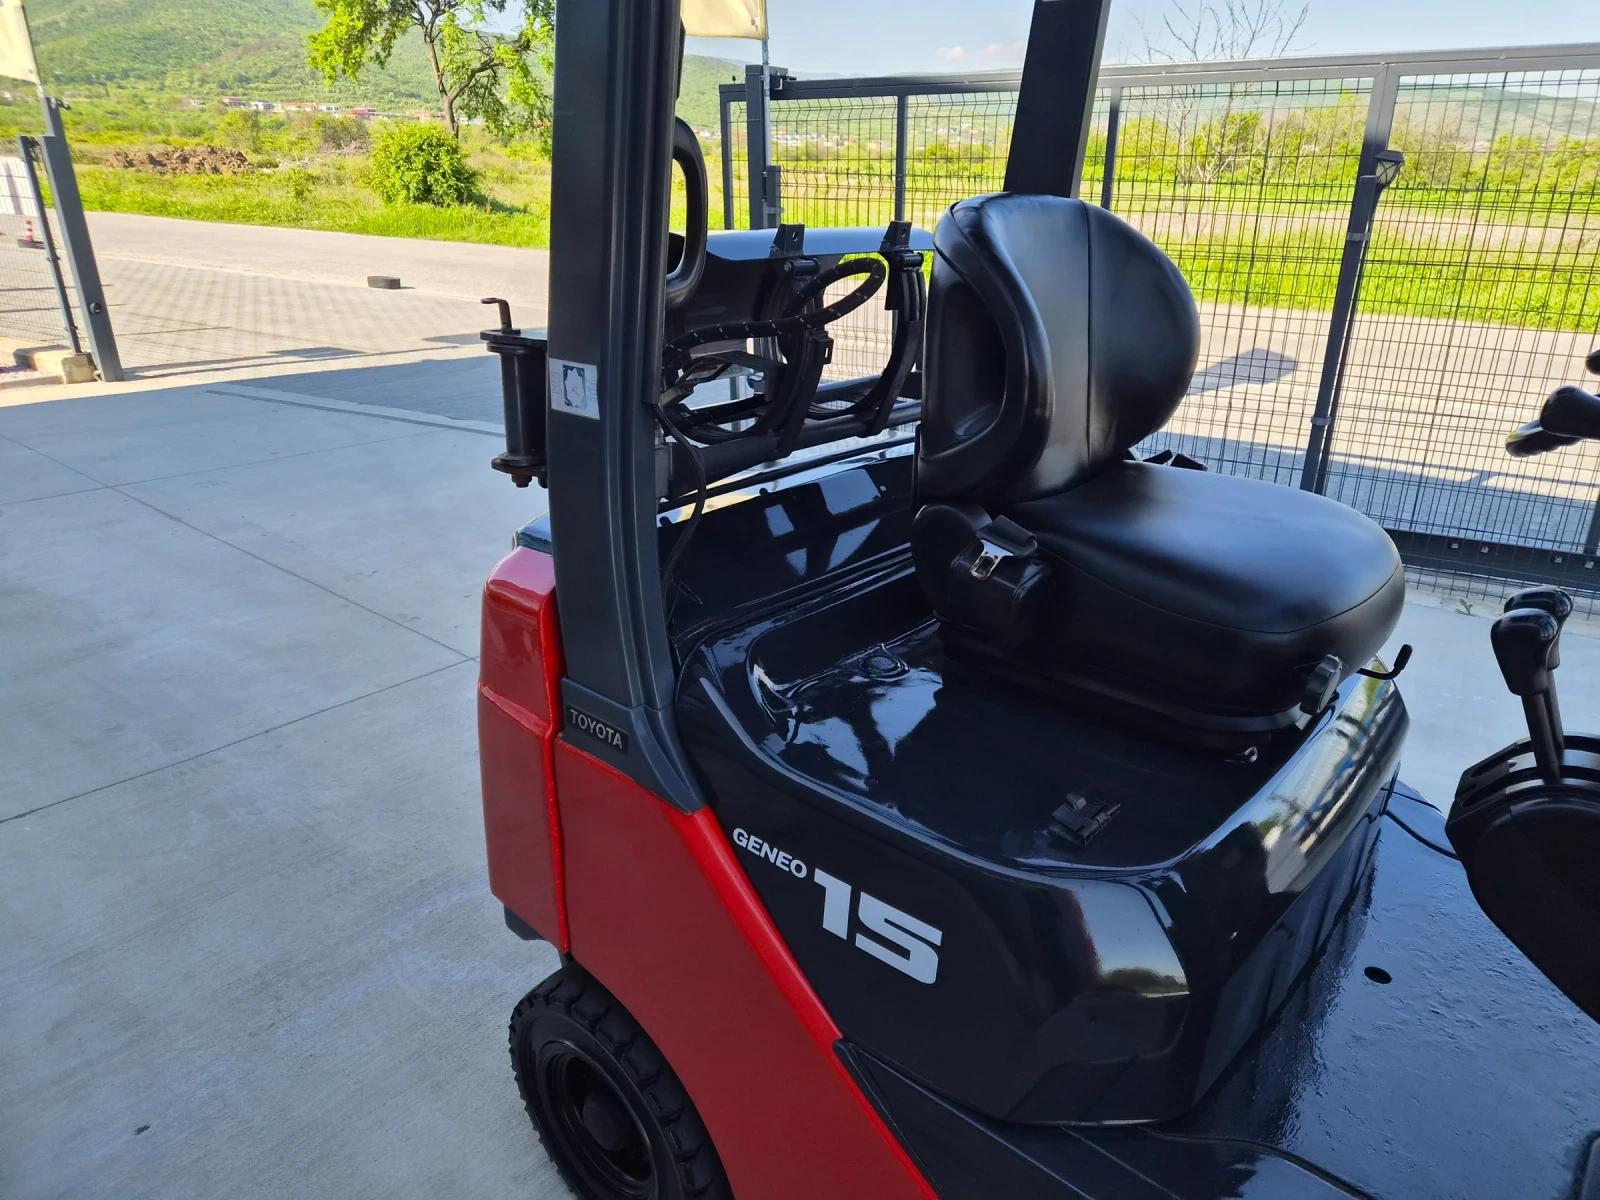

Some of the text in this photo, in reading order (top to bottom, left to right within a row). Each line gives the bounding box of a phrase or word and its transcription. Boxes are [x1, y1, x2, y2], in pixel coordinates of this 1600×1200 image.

[569, 708, 624, 750] TOYOTA
[732, 827, 943, 985] GENEO 15
